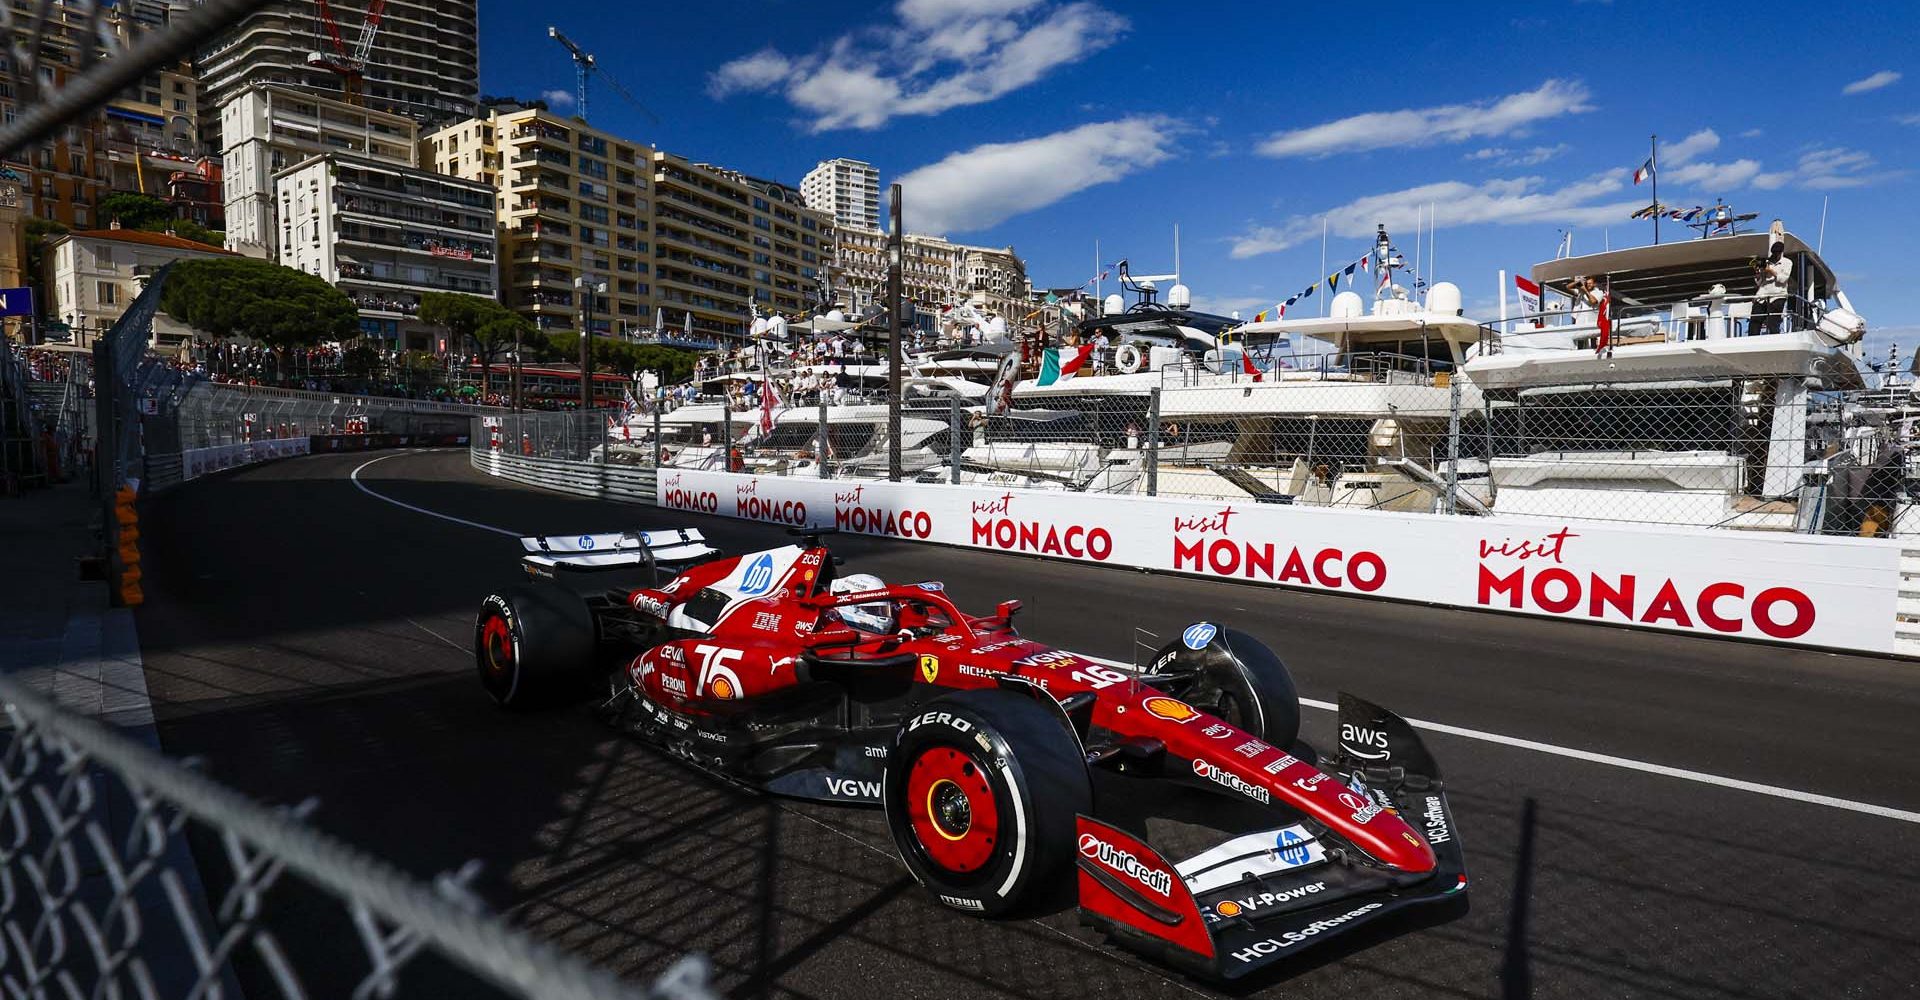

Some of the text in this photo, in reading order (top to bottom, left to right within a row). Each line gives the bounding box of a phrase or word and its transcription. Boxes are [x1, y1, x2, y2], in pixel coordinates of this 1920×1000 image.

[665, 489, 718, 513] MONACO
[736, 479, 759, 497] visit
[835, 486, 864, 504] visit
[736, 497, 807, 526] MONACO
[972, 491, 1016, 516] visit
[835, 505, 932, 539] MONACO
[1174, 506, 1239, 534] visit
[972, 517, 1113, 561] MONACO
[1479, 526, 1579, 563] visit
[801, 554, 821, 566] ZCG
[1173, 537, 1387, 592] MONACO
[742, 555, 772, 594] hp
[1478, 563, 1817, 640] MONACO
[752, 611, 782, 633] IBM
[794, 620, 813, 633] aws
[1185, 624, 1215, 650] hp
[1012, 650, 1073, 667] VGW
[1149, 650, 1177, 675] ZER
[661, 673, 686, 693] PERONI
[1071, 665, 1128, 690] 16
[908, 711, 972, 733] ZERO
[1342, 724, 1388, 749] aws
[825, 776, 881, 798] VGW
[1209, 765, 1270, 804] UniCredit
[1424, 796, 1451, 845] HCLSoftware
[1279, 831, 1308, 865] hp
[1099, 842, 1170, 896] UniCredit
[1237, 882, 1326, 911] V-Power
[1231, 902, 1383, 963] HCLSoftware
